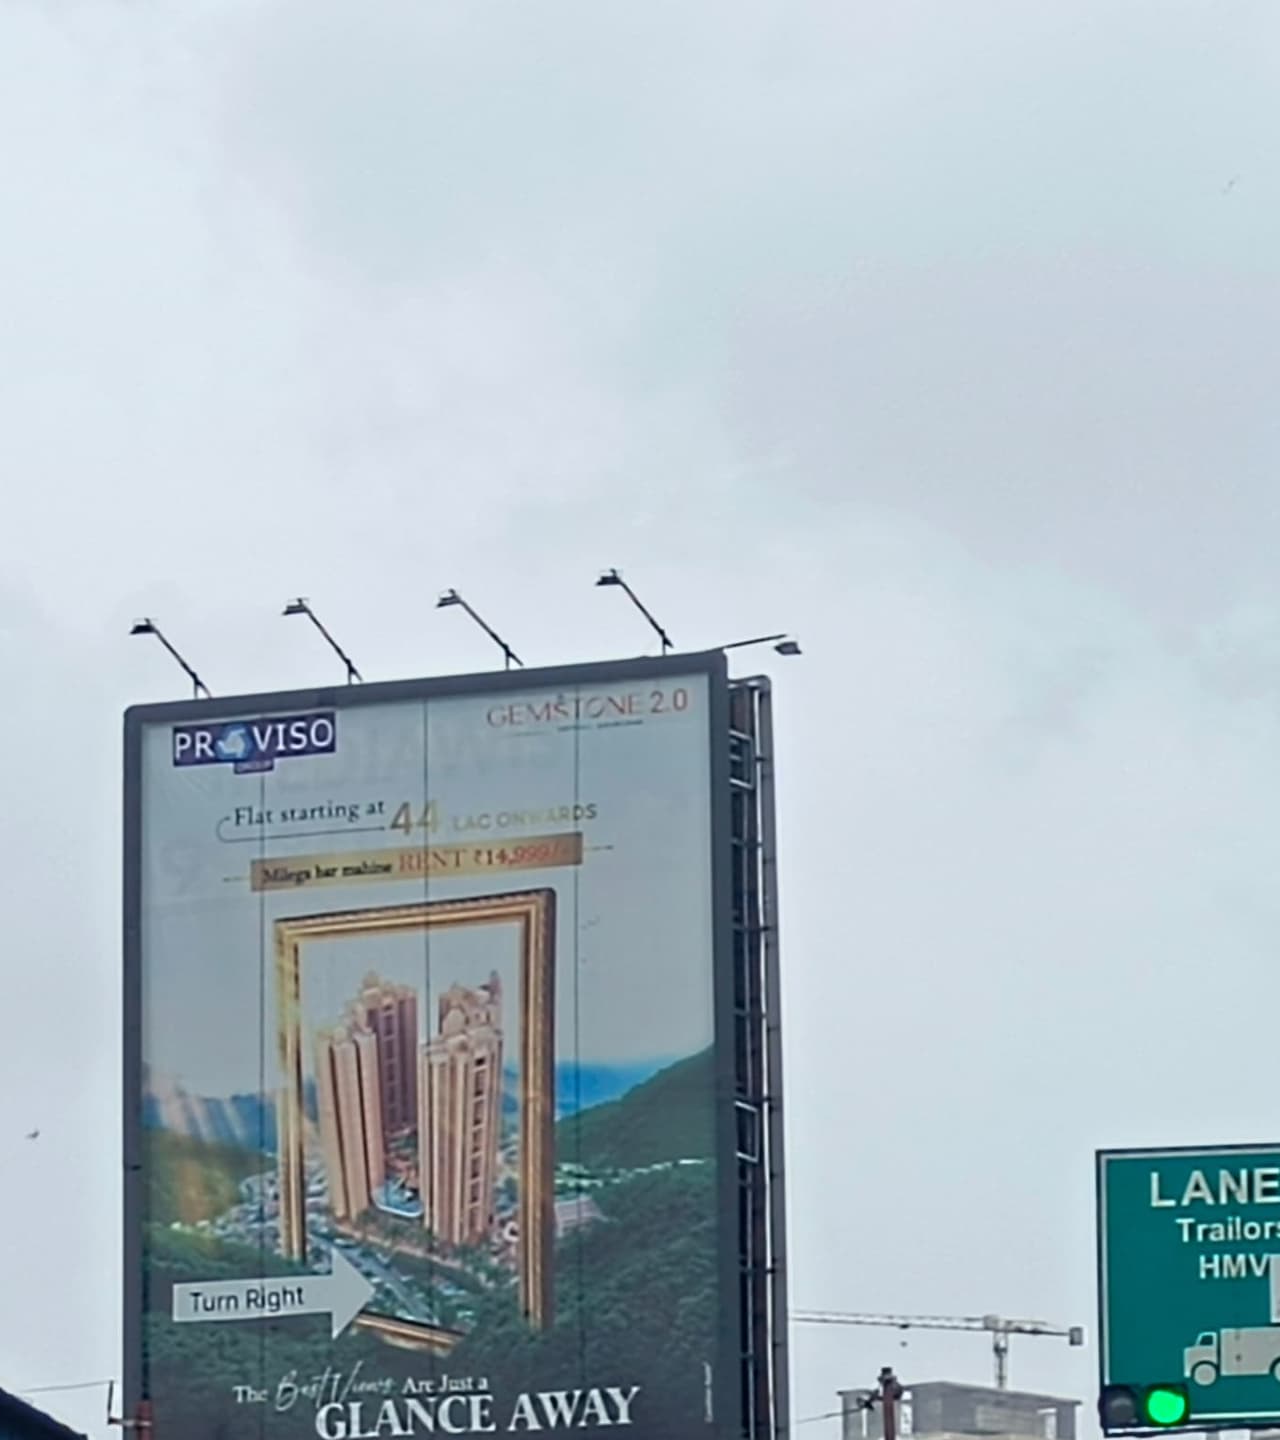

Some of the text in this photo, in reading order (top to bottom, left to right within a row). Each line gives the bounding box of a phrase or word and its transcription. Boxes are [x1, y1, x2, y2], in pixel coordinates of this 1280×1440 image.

[650, 689, 688, 714] 2.0
[235, 800, 385, 827] Flat starting at
[389, 799, 599, 837] 44 LAC ONWARDS
[398, 848, 466, 873] RENT
[1199, 1253, 1270, 1279] HMV
[190, 1286, 305, 1314] Turn Right
[232, 1384, 269, 1404] The
[402, 1377, 434, 1395] Are
[439, 1374, 473, 1394] Just
[477, 1376, 489, 1391] a
[507, 1386, 641, 1432] AWAY
